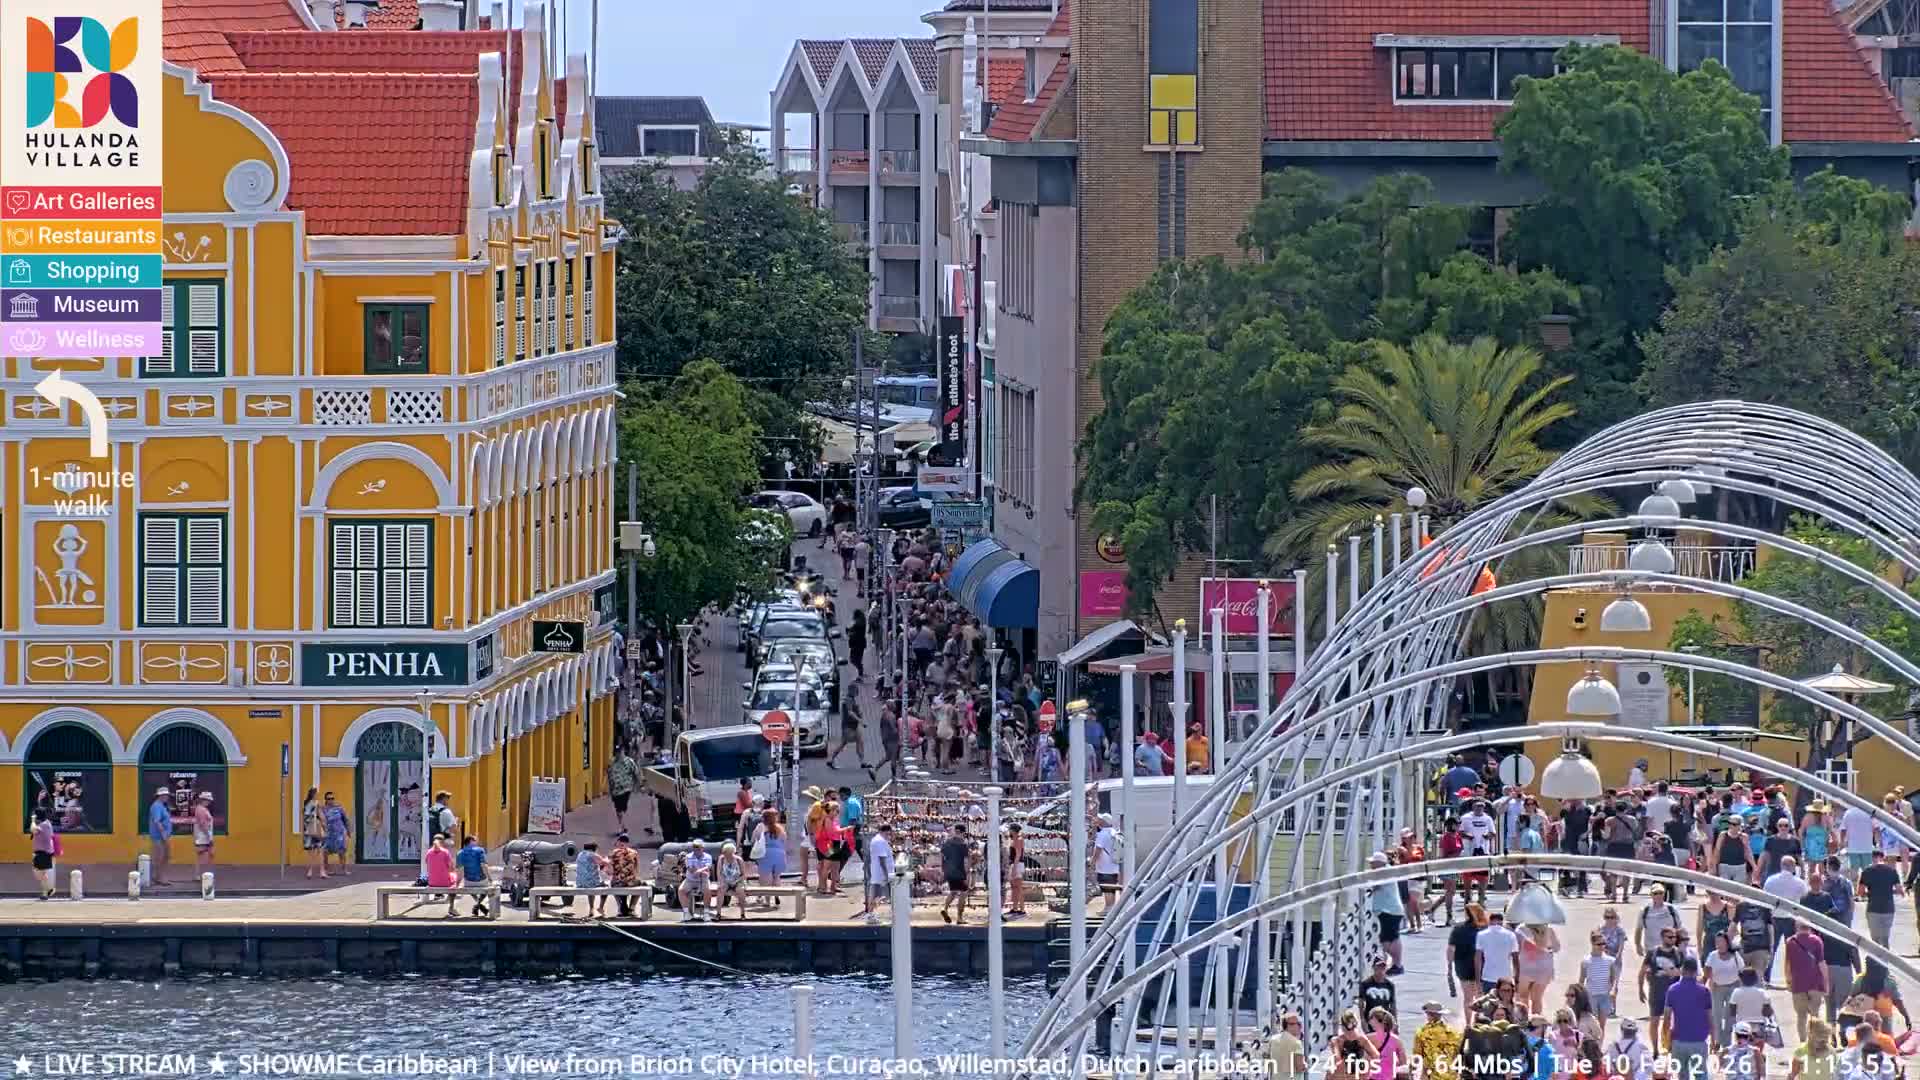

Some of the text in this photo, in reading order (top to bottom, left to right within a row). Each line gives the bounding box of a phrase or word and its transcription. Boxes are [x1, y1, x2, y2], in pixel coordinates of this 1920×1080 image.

[948, 334, 959, 442] the athlete's foot
[326, 652, 444, 677] PENHA
